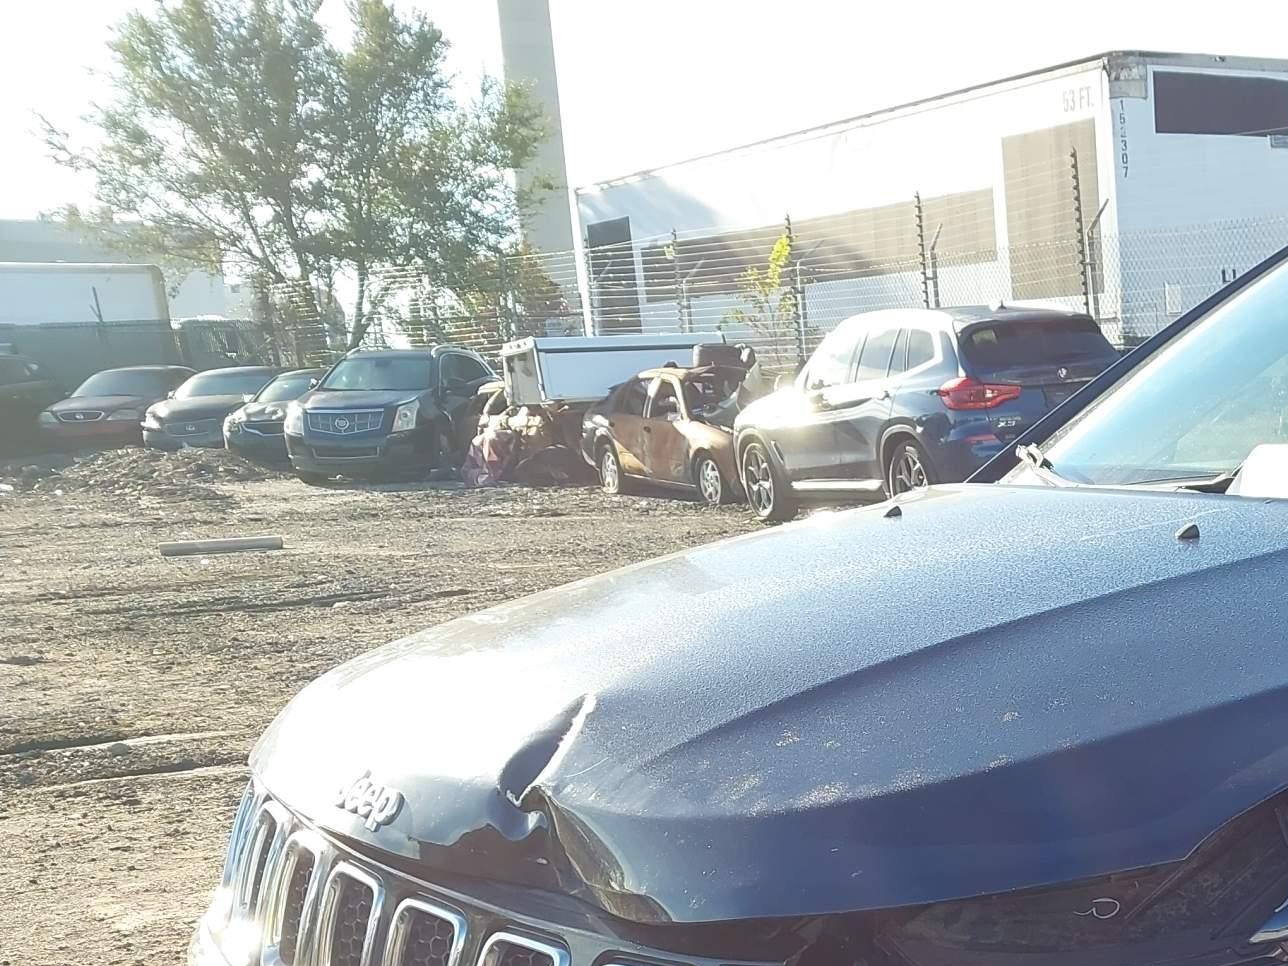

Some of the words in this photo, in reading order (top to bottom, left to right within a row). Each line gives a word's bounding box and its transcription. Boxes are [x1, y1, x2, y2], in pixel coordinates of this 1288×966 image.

[1062, 89, 1076, 113] 53
[997, 420, 1016, 428] X3
[335, 768, 406, 834] Jeep
